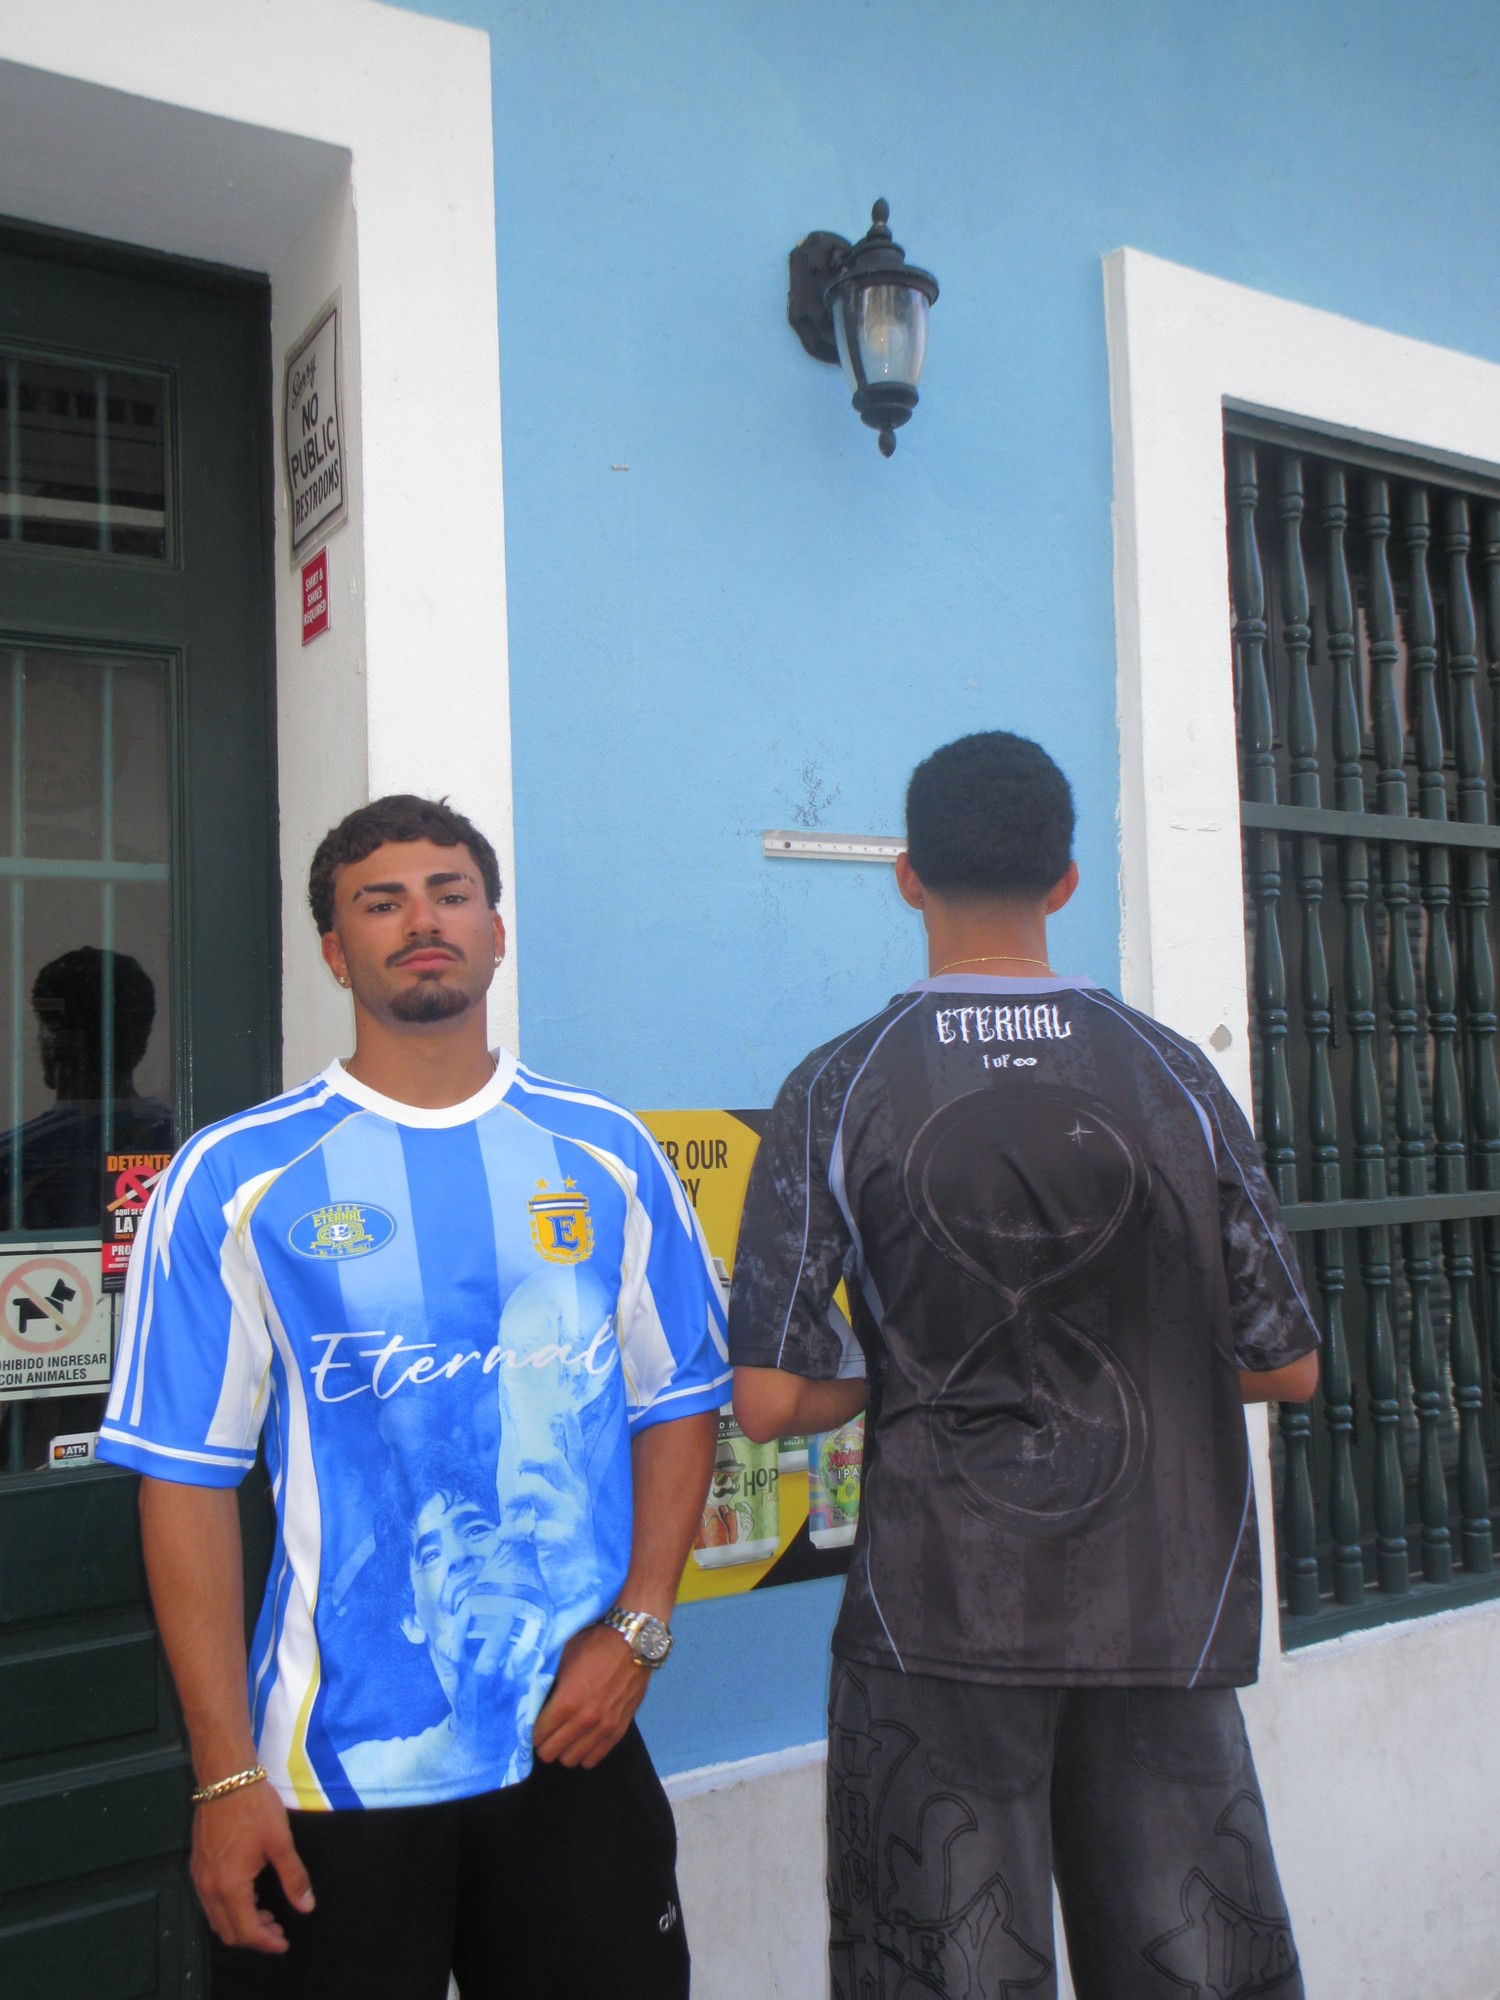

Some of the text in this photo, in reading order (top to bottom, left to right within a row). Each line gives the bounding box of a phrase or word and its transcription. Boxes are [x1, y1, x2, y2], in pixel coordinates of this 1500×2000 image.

[292, 352, 316, 410] Sorry
[302, 392, 318, 437] NO
[291, 416, 335, 489] PUBLIC
[295, 459, 339, 528] RESTROOMS
[305, 570, 319, 592] SHIRT
[307, 585, 322, 608] SHOES
[304, 598, 326, 627] REQUIRED
[936, 1004, 1072, 1044] ETERNAL
[107, 1154, 171, 1172] DETENTE
[686, 1139, 728, 1170] OUR
[115, 1216, 134, 1233] LA
[312, 1209, 366, 1228] ETERNAL
[330, 1224, 351, 1240] E
[546, 1216, 581, 1251] E
[112, 1245, 132, 1256] PRO
[0, 1353, 107, 1371] HIBIDO INGRESAR
[310, 1314, 616, 1403] Eternal
[0, 1368, 87, 1386] CON ANIMALES
[66, 1444, 86, 1455] ATH
[744, 1468, 779, 1497] HOP
[838, 1468, 860, 1480] IPA
